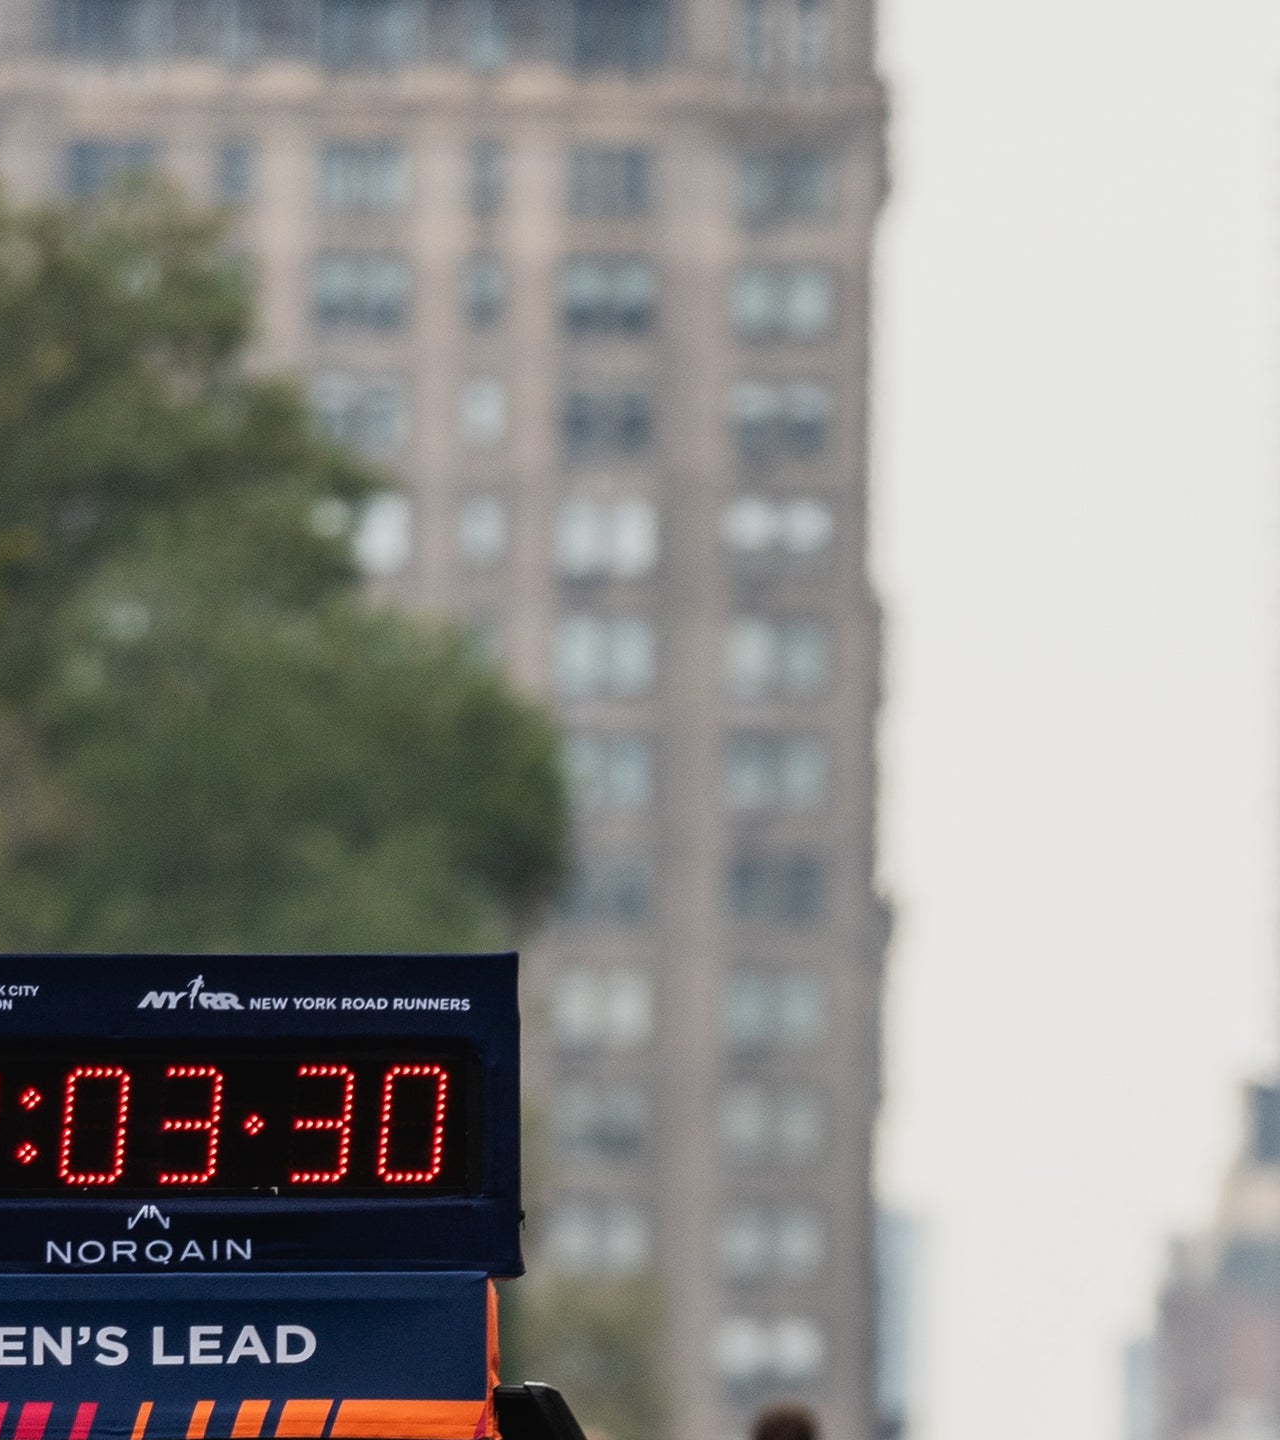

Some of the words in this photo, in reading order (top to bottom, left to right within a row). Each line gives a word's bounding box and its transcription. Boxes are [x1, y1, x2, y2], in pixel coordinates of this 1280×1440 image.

[8, 984, 40, 997] CITY
[249, 997, 289, 1010] NEW
[292, 997, 337, 1010] YORK
[341, 997, 389, 1010] ROAD
[392, 997, 471, 1012] RUNNERS
[46, 1238, 252, 1265] NORQAIN
[152, 1324, 317, 1366] LEAD
